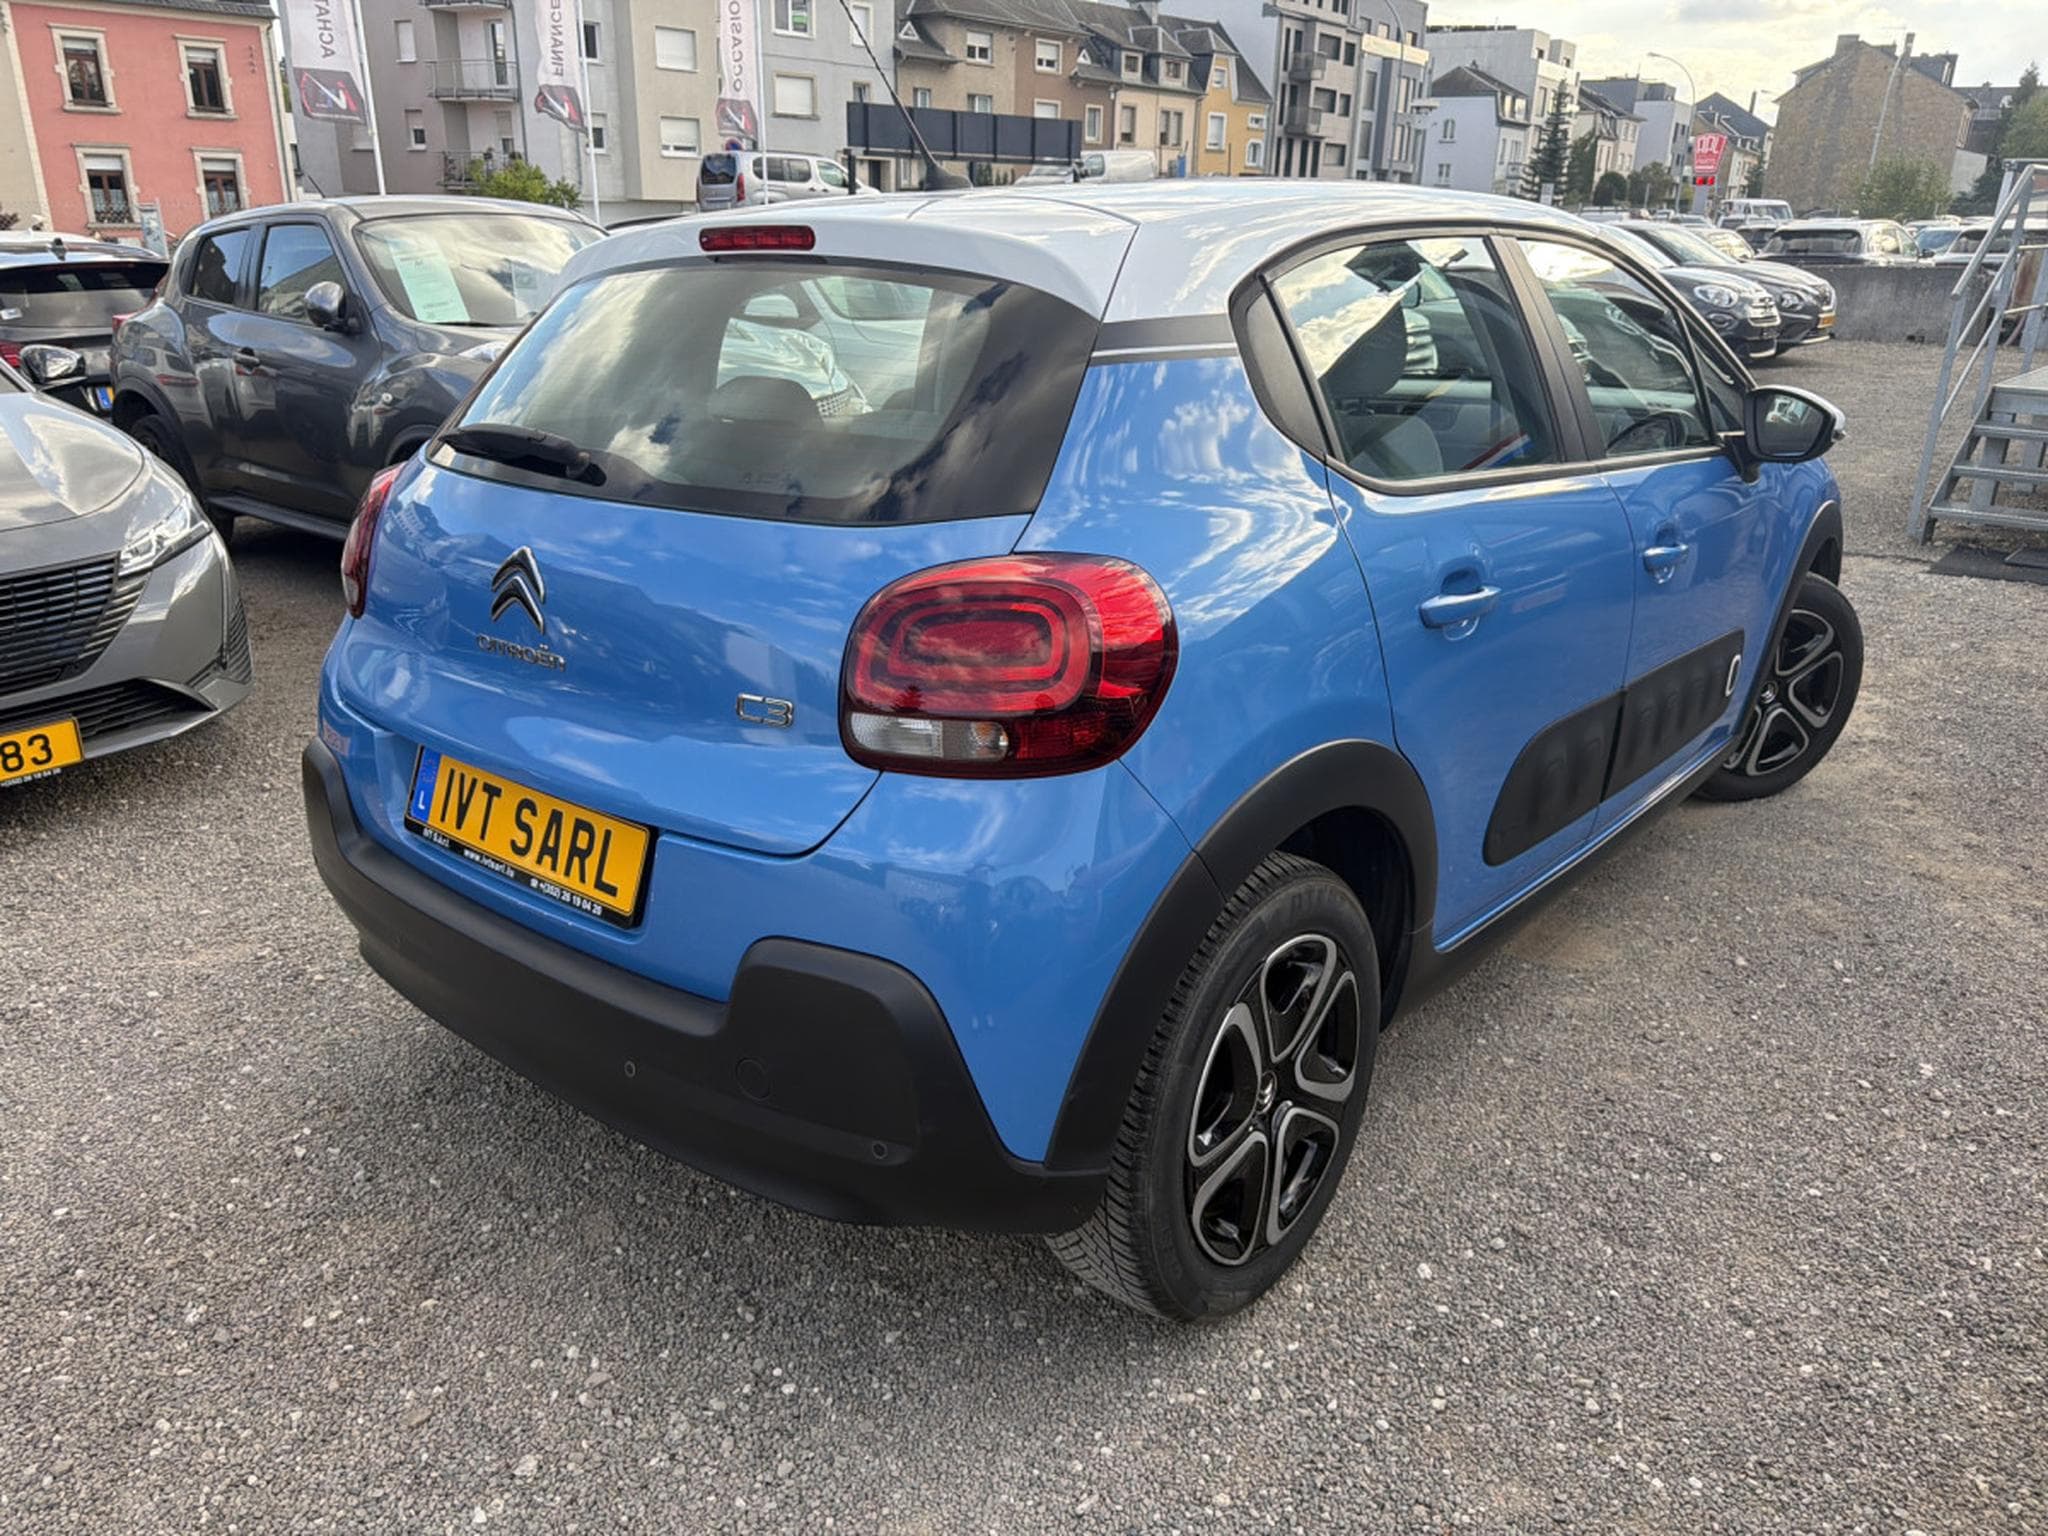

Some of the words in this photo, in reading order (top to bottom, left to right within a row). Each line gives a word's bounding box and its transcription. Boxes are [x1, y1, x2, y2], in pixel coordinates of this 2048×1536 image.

[736, 692, 794, 728] C3
[0, 733, 53, 773] 83
[440, 767, 503, 842] IVT
[510, 797, 618, 898] SARL
